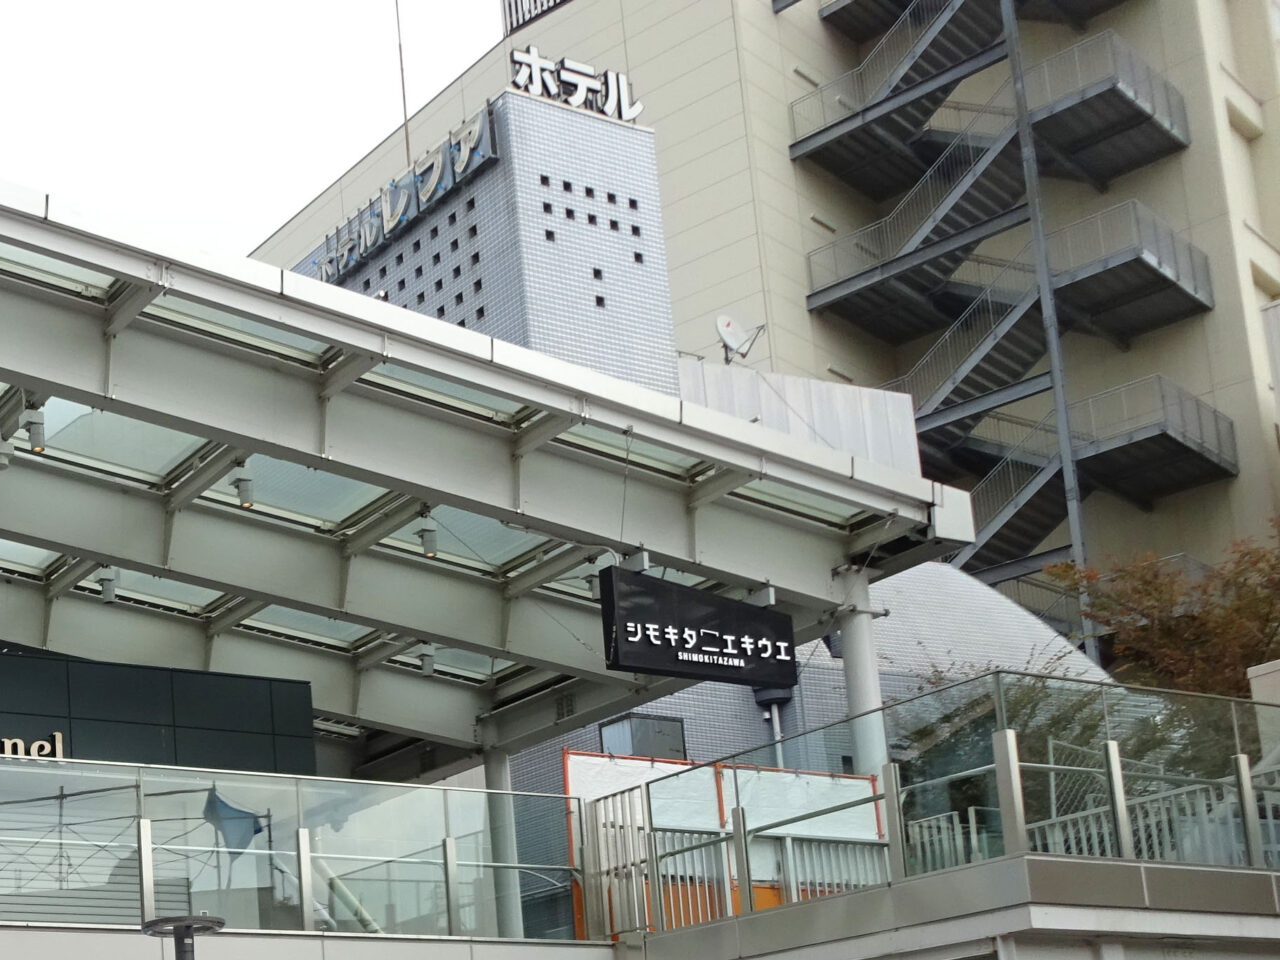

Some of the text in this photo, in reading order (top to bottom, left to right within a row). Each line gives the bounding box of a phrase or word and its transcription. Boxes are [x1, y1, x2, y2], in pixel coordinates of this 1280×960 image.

[512, 45, 645, 121] ホテル
[677, 651, 746, 668] SHIMOKITAZAWA
